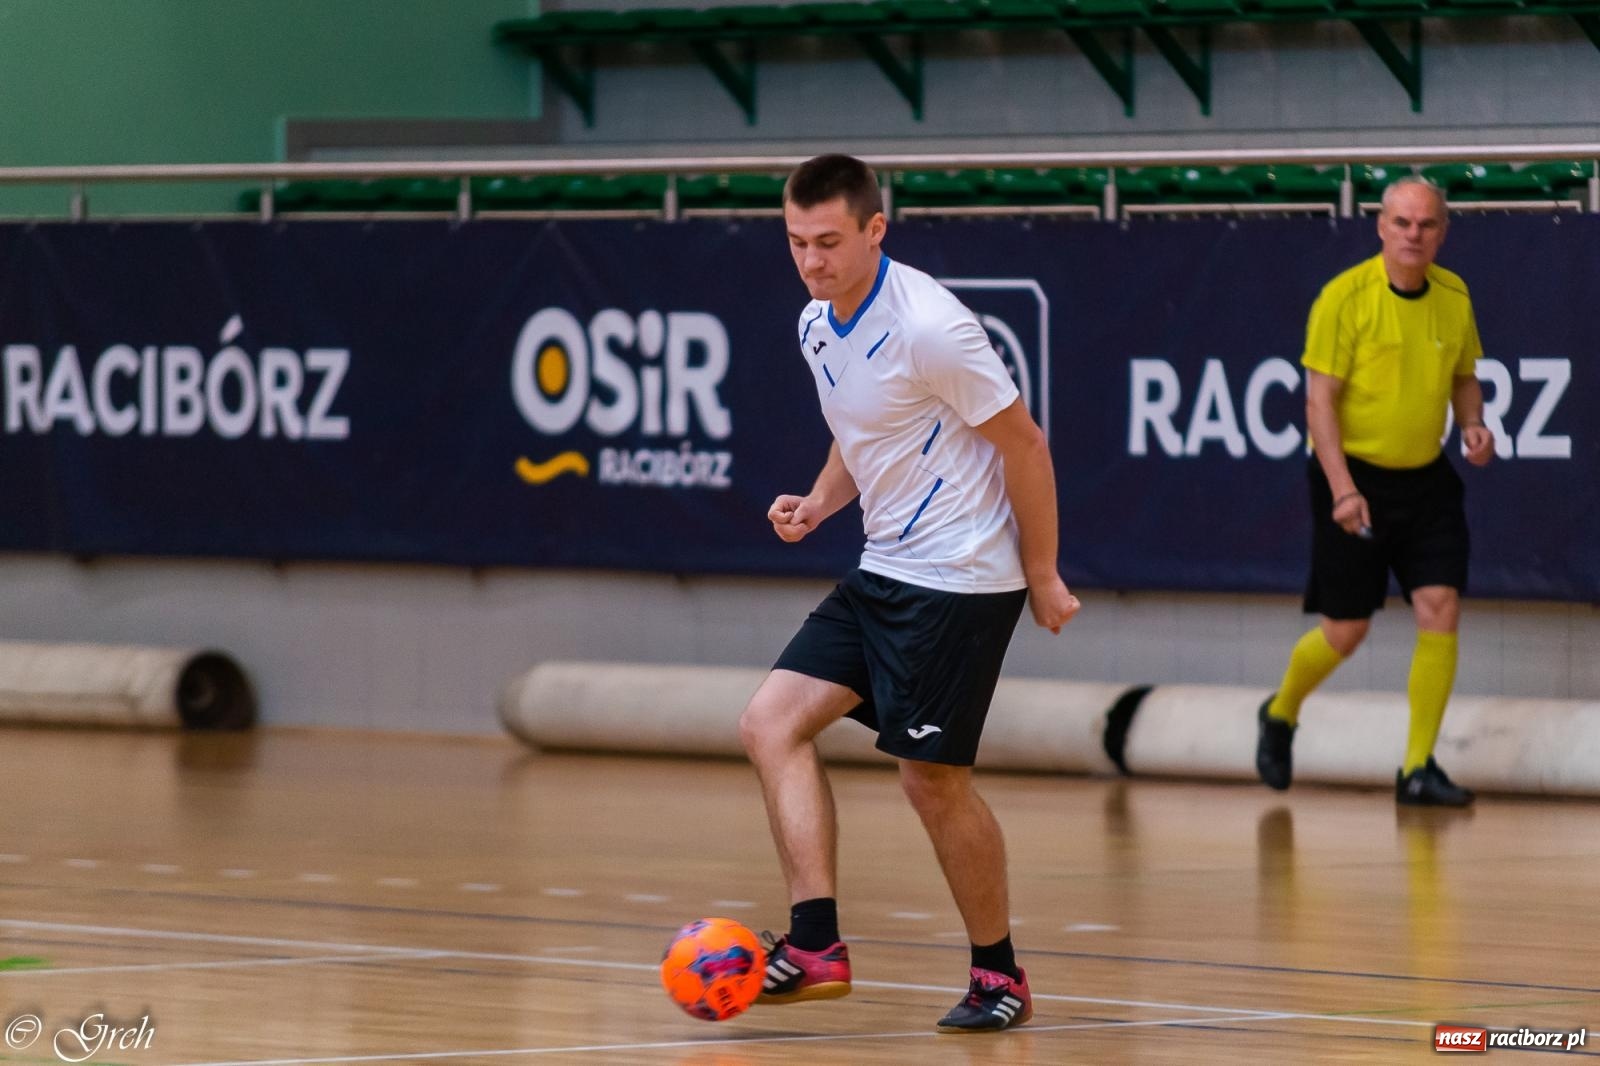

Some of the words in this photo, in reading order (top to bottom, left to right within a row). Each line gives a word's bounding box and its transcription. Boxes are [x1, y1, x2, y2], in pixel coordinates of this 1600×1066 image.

[4, 314, 350, 440] RACIBÓRZ
[1128, 357, 1572, 459] RACRZ
[598, 440, 732, 489] RACIBÓRZ
